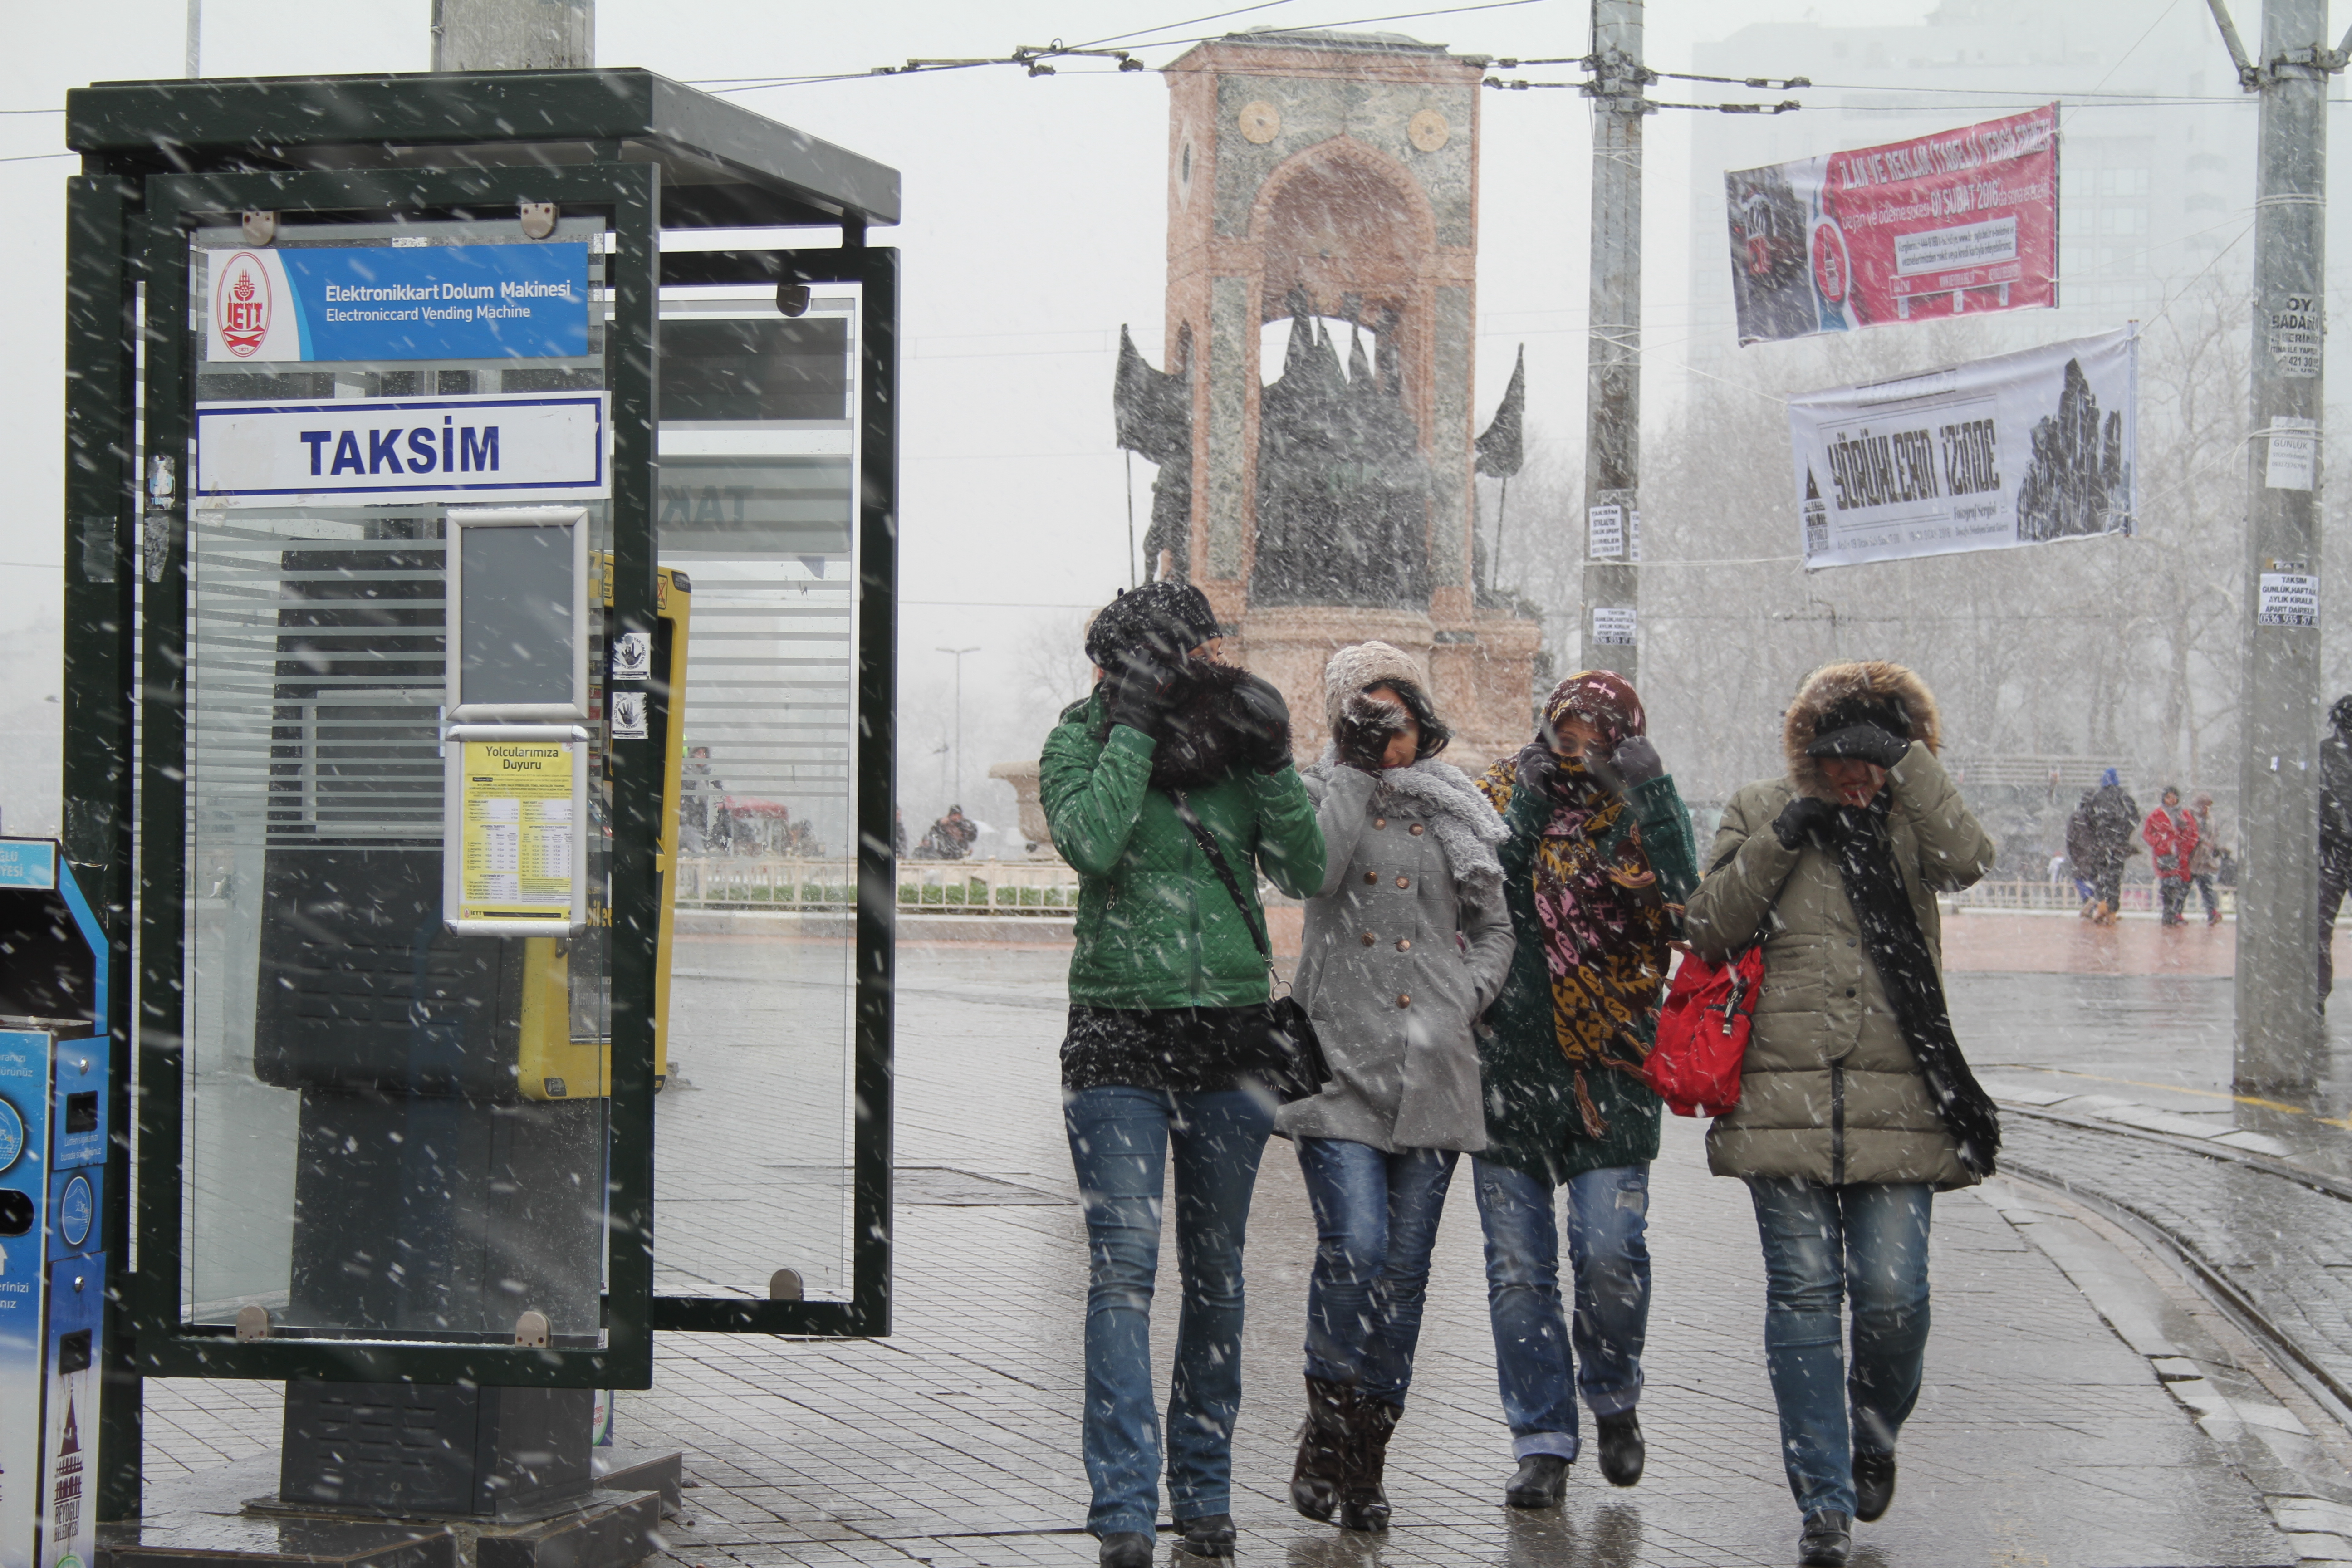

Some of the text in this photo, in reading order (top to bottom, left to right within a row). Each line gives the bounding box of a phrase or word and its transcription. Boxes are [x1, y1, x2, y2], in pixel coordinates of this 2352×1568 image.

[1839, 157, 1869, 190] İLAN
[1867, 153, 1887, 185] VE
[1885, 145, 1934, 181] REKLAM
[1929, 132, 1982, 176] (TABELA)
[1839, 209, 1866, 234] beyan
[1867, 211, 1877, 225] ve
[1931, 191, 1942, 218] 01
[1942, 184, 1975, 223] ŞUBAT
[326, 280, 571, 302] Elektronikkart Dolum Makinesi
[326, 304, 530, 323] Electroniccard Vending Machine
[2288, 345, 2298, 353] İLE
[2288, 356, 2301, 366] 421
[2304, 357, 2313, 367] 30
[300, 415, 499, 476] TAKSİM
[2274, 437, 2307, 450] GÜNLÜK
[2260, 614, 2279, 623] 0536
[2283, 614, 2298, 624] 935
[2301, 615, 2311, 626] 87
[486, 746, 559, 758] Yolcularımıza
[503, 759, 542, 772] Duyuru
[0, 1066, 33, 1077] ürünüz
[0, 1300, 16, 1308] nız
[55, 1498, 80, 1525] BEYOĞLU
[54, 1519, 79, 1543] BELEDİYESİ
